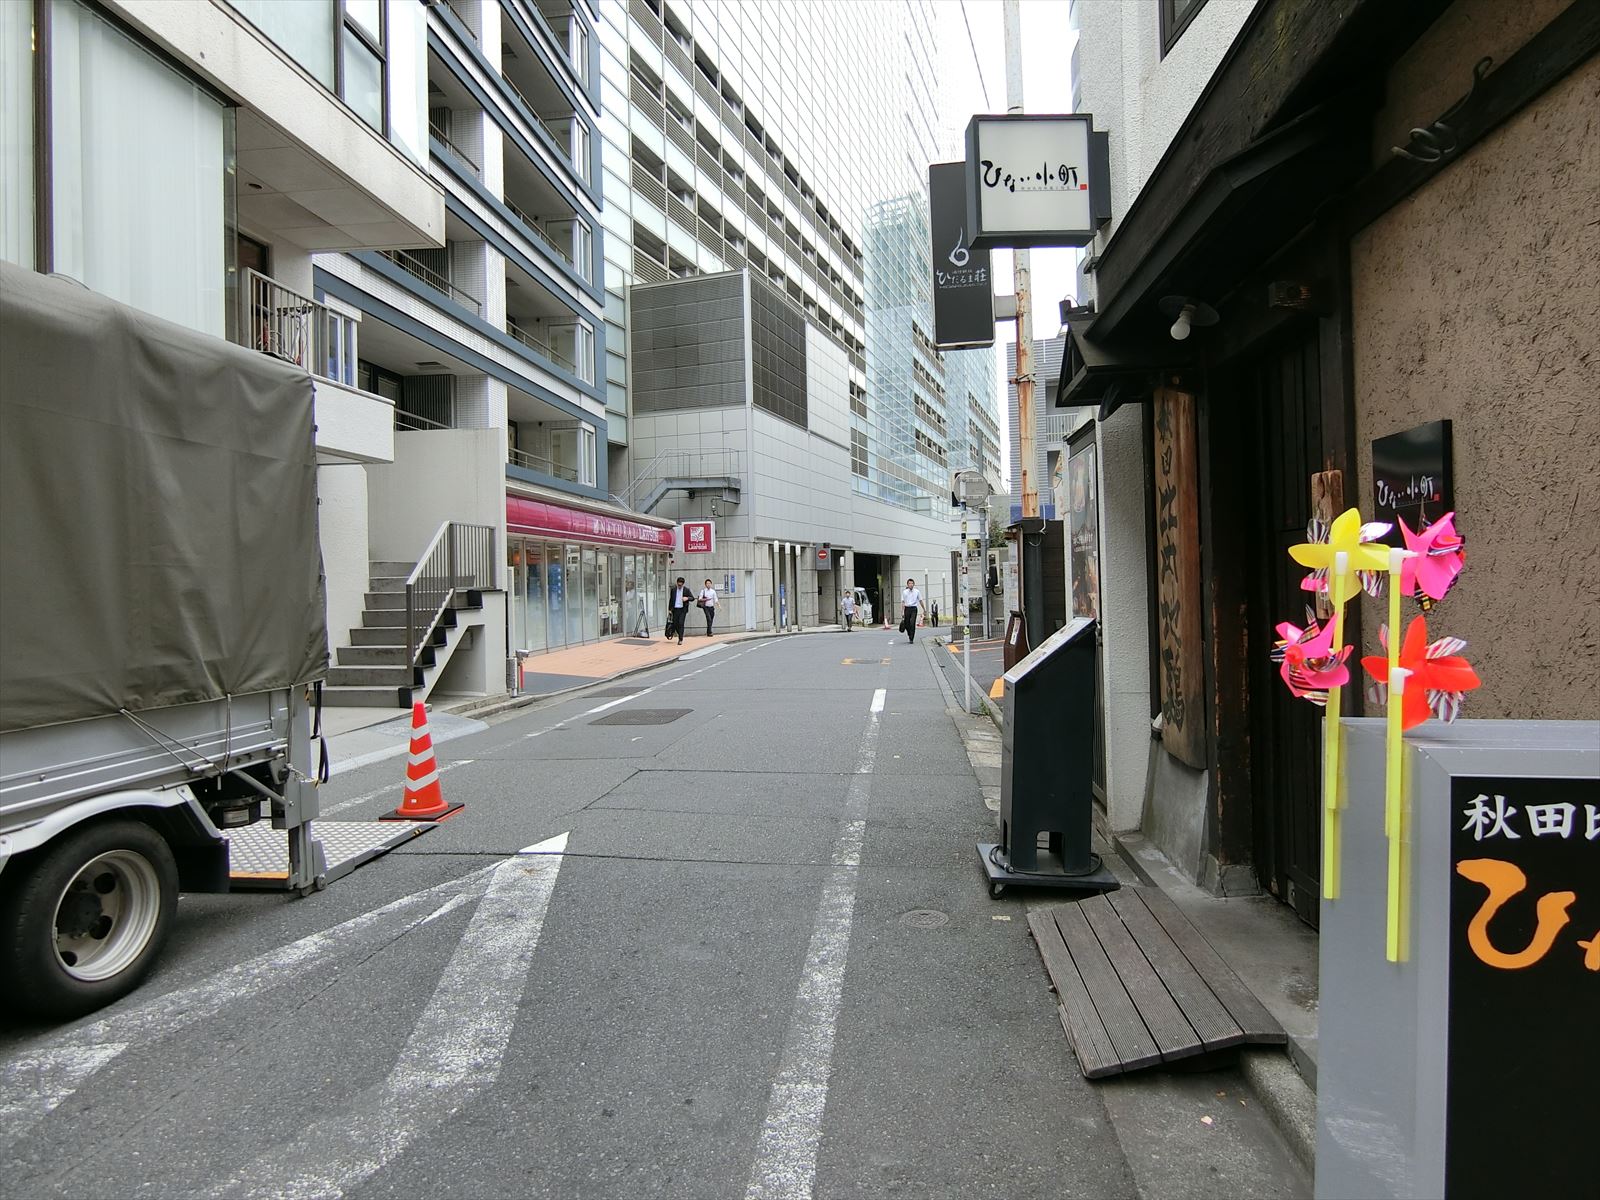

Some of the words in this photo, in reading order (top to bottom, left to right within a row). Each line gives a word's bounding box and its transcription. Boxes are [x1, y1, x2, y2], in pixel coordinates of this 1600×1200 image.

[981, 160, 1078, 192] ひない小町
[1376, 474, 1434, 509] ひない小町
[599, 519, 639, 538] NATURAL
